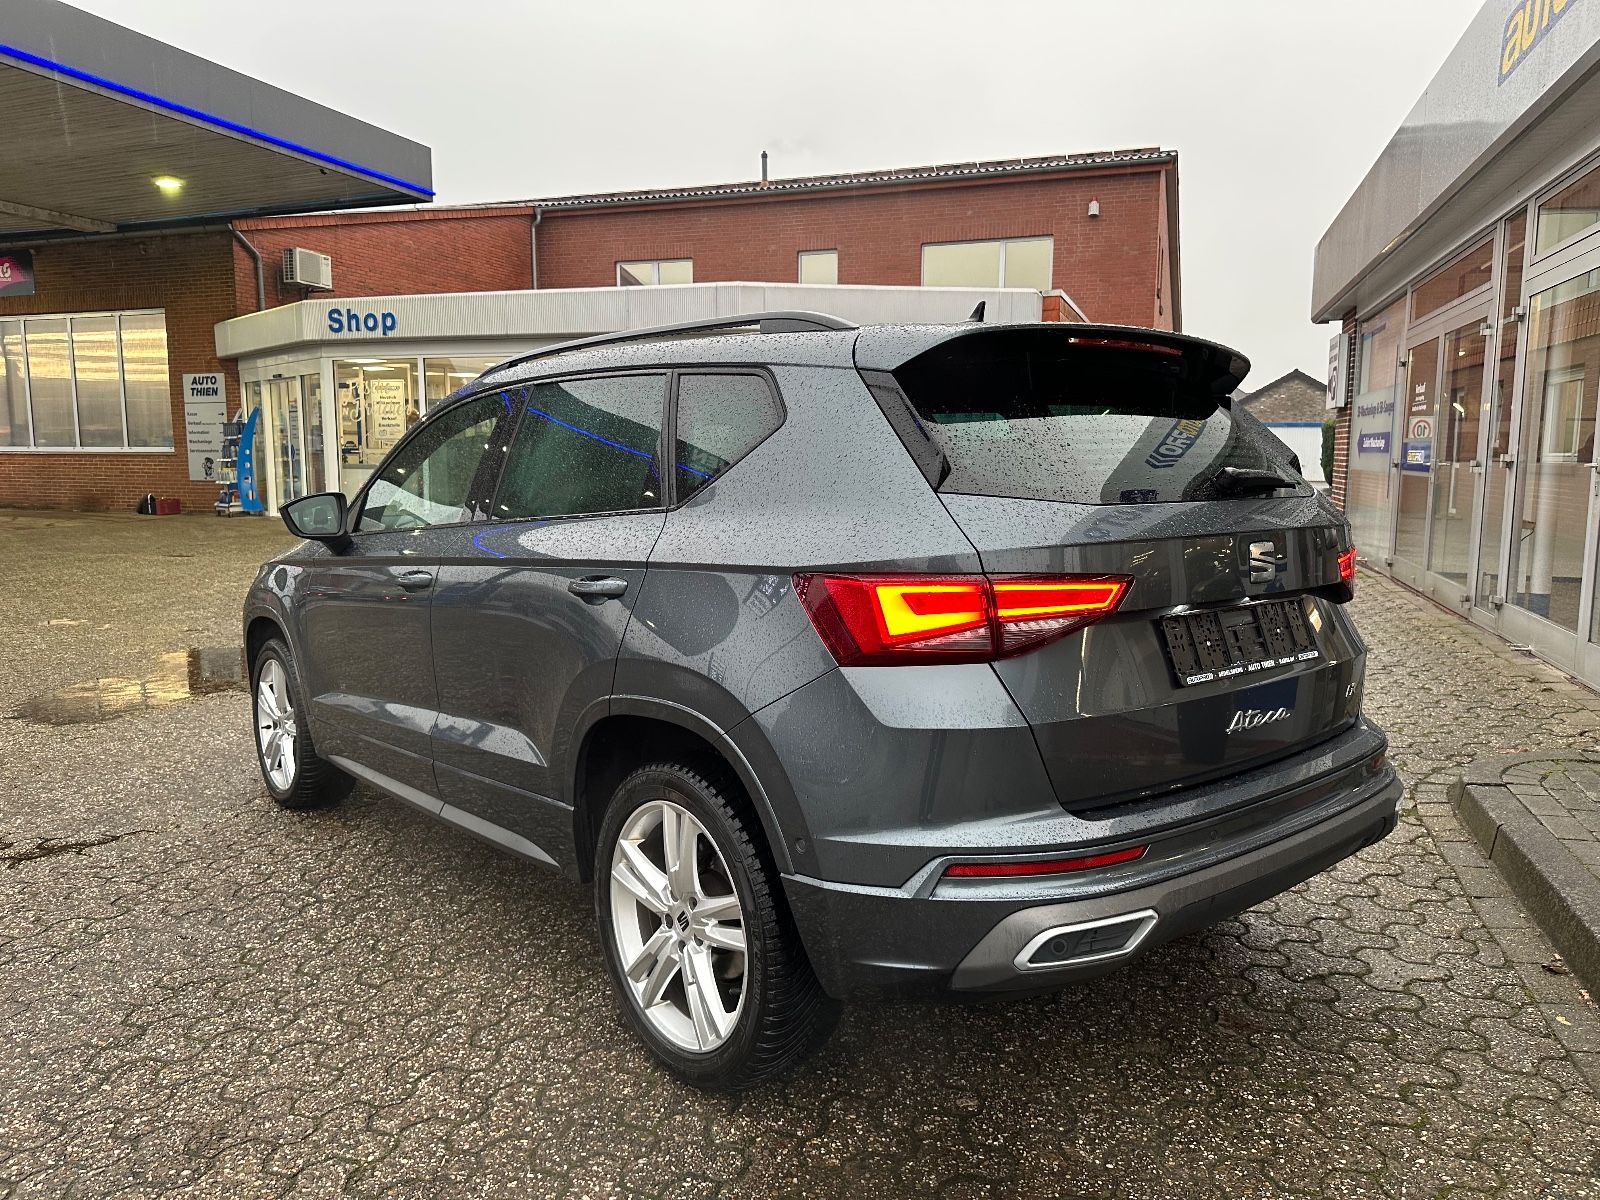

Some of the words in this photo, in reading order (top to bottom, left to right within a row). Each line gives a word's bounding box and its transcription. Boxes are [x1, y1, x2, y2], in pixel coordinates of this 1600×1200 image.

[328, 308, 396, 336] Shop
[191, 375, 217, 386] AUTO
[190, 386, 218, 397] THIEN
[1226, 707, 1291, 735] Ateca
